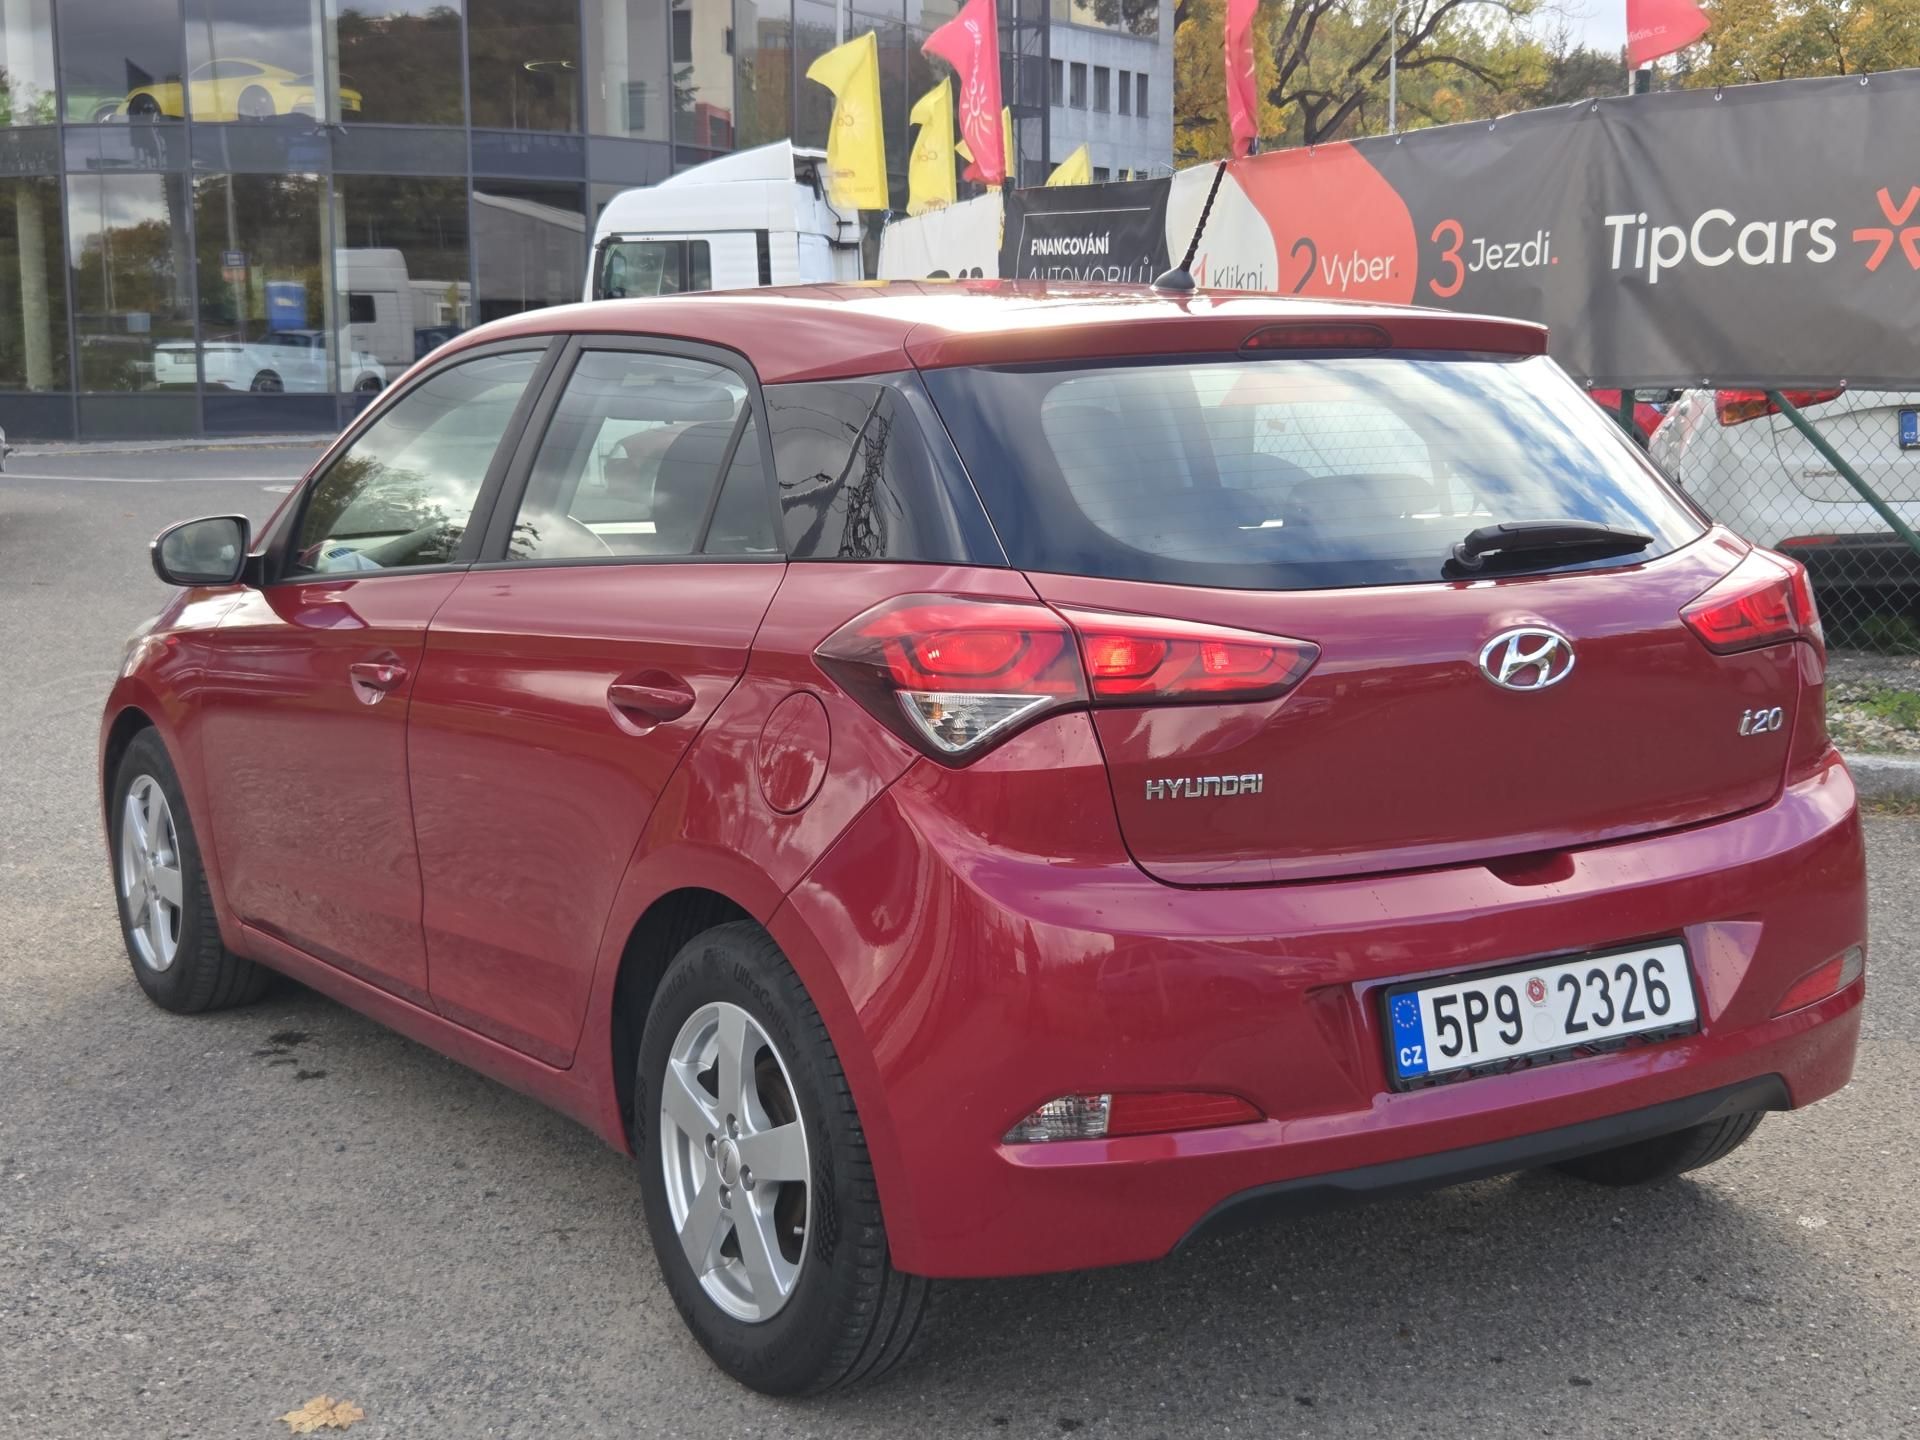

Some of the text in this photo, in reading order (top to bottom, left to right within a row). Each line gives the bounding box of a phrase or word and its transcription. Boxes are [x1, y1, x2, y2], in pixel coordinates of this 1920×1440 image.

[1030, 231, 1110, 256] FINANCOVÁNÍ
[1605, 209, 1836, 284] TipCars
[1290, 237, 1318, 294] 2
[1321, 248, 1399, 292] Vyber.
[1429, 219, 1465, 298] 3
[1468, 230, 1559, 273] Jezdi.
[1904, 431, 1915, 439] CZ
[1737, 706, 1783, 737] i20
[1145, 774, 1263, 801] HYUNDAI
[1432, 958, 1671, 1058] 5P9 2326
[1399, 1045, 1424, 1067] CZ
